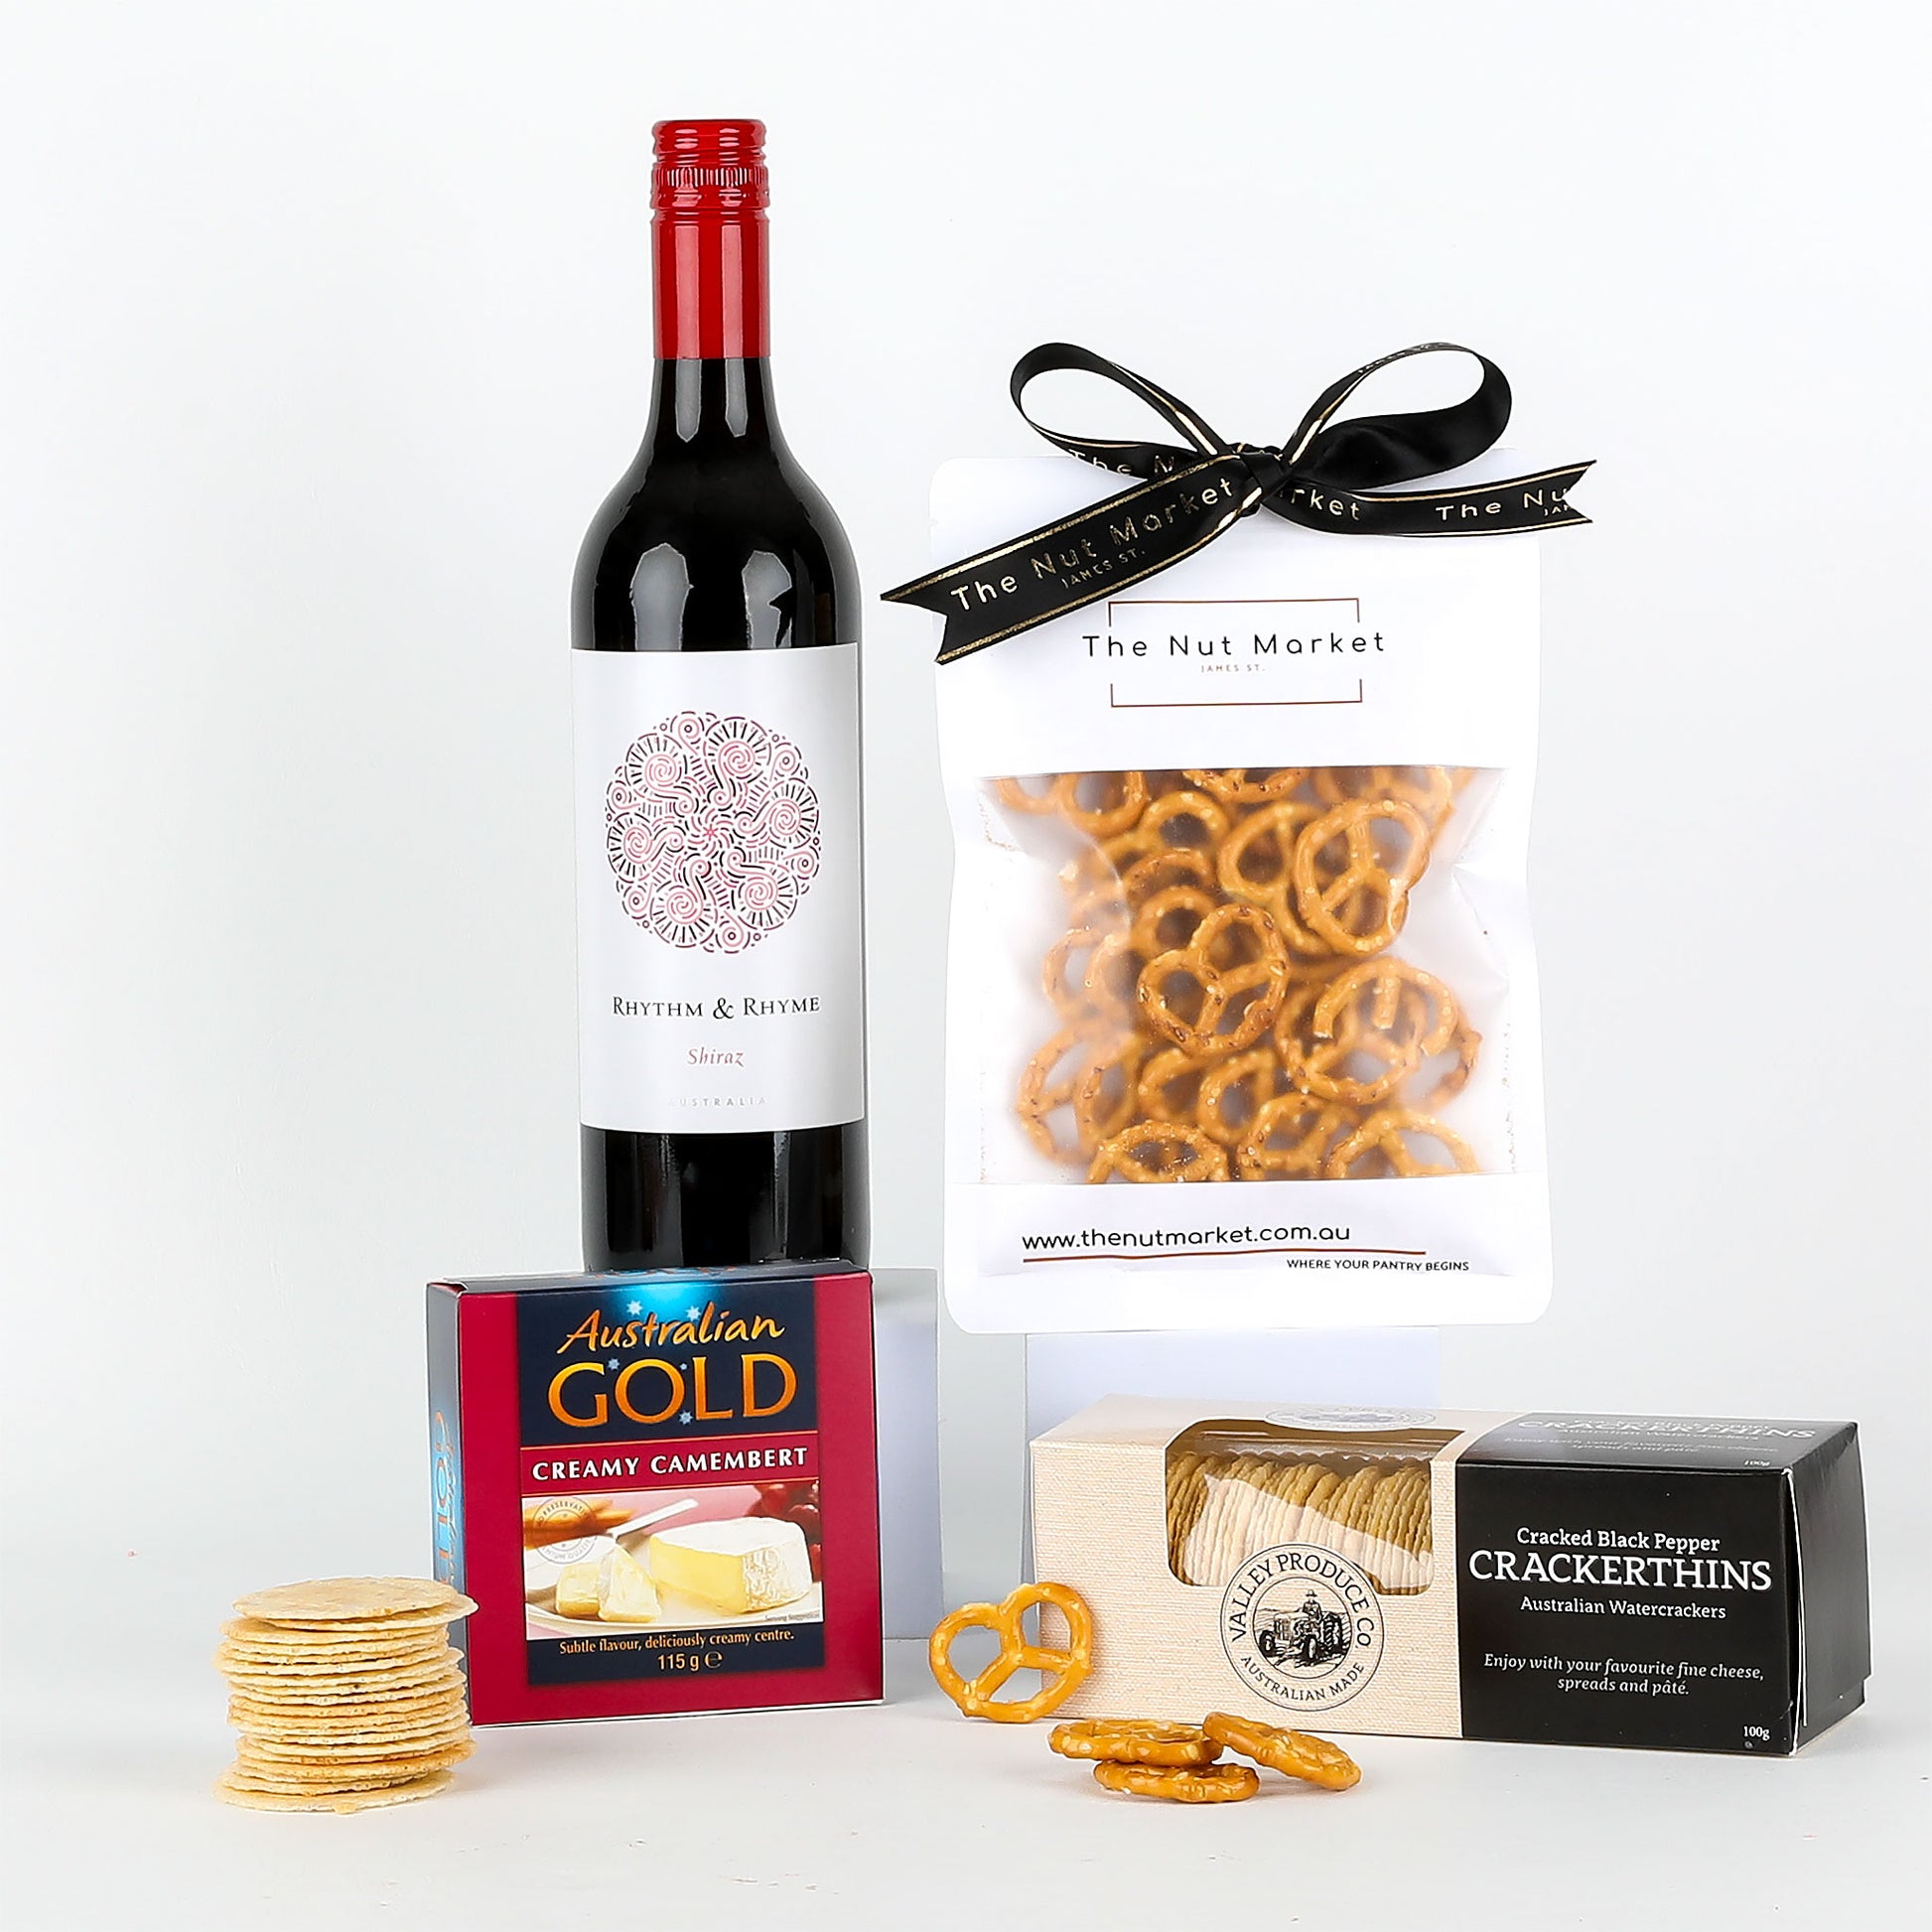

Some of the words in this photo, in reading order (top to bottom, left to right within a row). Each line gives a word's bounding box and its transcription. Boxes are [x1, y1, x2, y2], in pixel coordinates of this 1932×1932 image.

[1291, 488, 1360, 521] rket
[1436, 502, 1502, 520] The
[1524, 487, 1568, 508] Nu
[950, 575, 1018, 612] The
[1030, 537, 1097, 580] Nut
[1109, 478, 1232, 546] Market
[1061, 560, 1113, 589] JAMES
[1118, 548, 1146, 568] ST.
[1082, 635, 1148, 657] The
[1170, 634, 1232, 656] Nut
[1254, 632, 1384, 654] Market
[1200, 664, 1239, 673] JAMES
[1247, 663, 1266, 672] ST.
[712, 997, 735, 1019] &
[687, 1046, 745, 1068] Shiraz
[1022, 1225, 1350, 1250] www.thenutmarket.com.au
[1287, 1259, 1331, 1270] WHERE
[1334, 1259, 1369, 1270] YOUR
[1372, 1260, 1423, 1272] PANTRY
[1426, 1261, 1469, 1272] BEGINS
[557, 1302, 785, 1354] Australian
[547, 1352, 798, 1428] GOLD
[531, 1456, 639, 1481] CREAMY
[650, 1447, 808, 1474] CAMEMBERT
[1517, 1527, 1593, 1547] Cracked
[1597, 1530, 1650, 1550] Black
[1654, 1534, 1721, 1555] Pepper
[1468, 1550, 1772, 1590] CRACKERTHINS
[1228, 1560, 1274, 1643] VALLEY
[1276, 1552, 1370, 1613] PRODUCE
[1520, 1595, 1605, 1615] Australian
[1608, 1599, 1726, 1619] Watercrackers
[560, 1640, 596, 1655] Subtle
[599, 1637, 642, 1652] flavour,
[645, 1633, 706, 1650] deliciously
[709, 1630, 752, 1647] creamy
[755, 1629, 794, 1642] centre.
[657, 1653, 685, 1671] 115
[1483, 1653, 1526, 1672] Enjoy
[1529, 1656, 1564, 1670] with
[1566, 1660, 1602, 1674] your
[1603, 1658, 1675, 1676] favourite
[1677, 1662, 1707, 1679] fine
[1710, 1663, 1764, 1681] cheese,
[1241, 1656, 1325, 1702] AUSTRALIAN
[1330, 1663, 1364, 1698] MADE
[1557, 1676, 1616, 1692] spreads
[1619, 1678, 1648, 1693] and
[1652, 1680, 1690, 1697] pâté.
[1743, 1725, 1770, 1741] 100g
